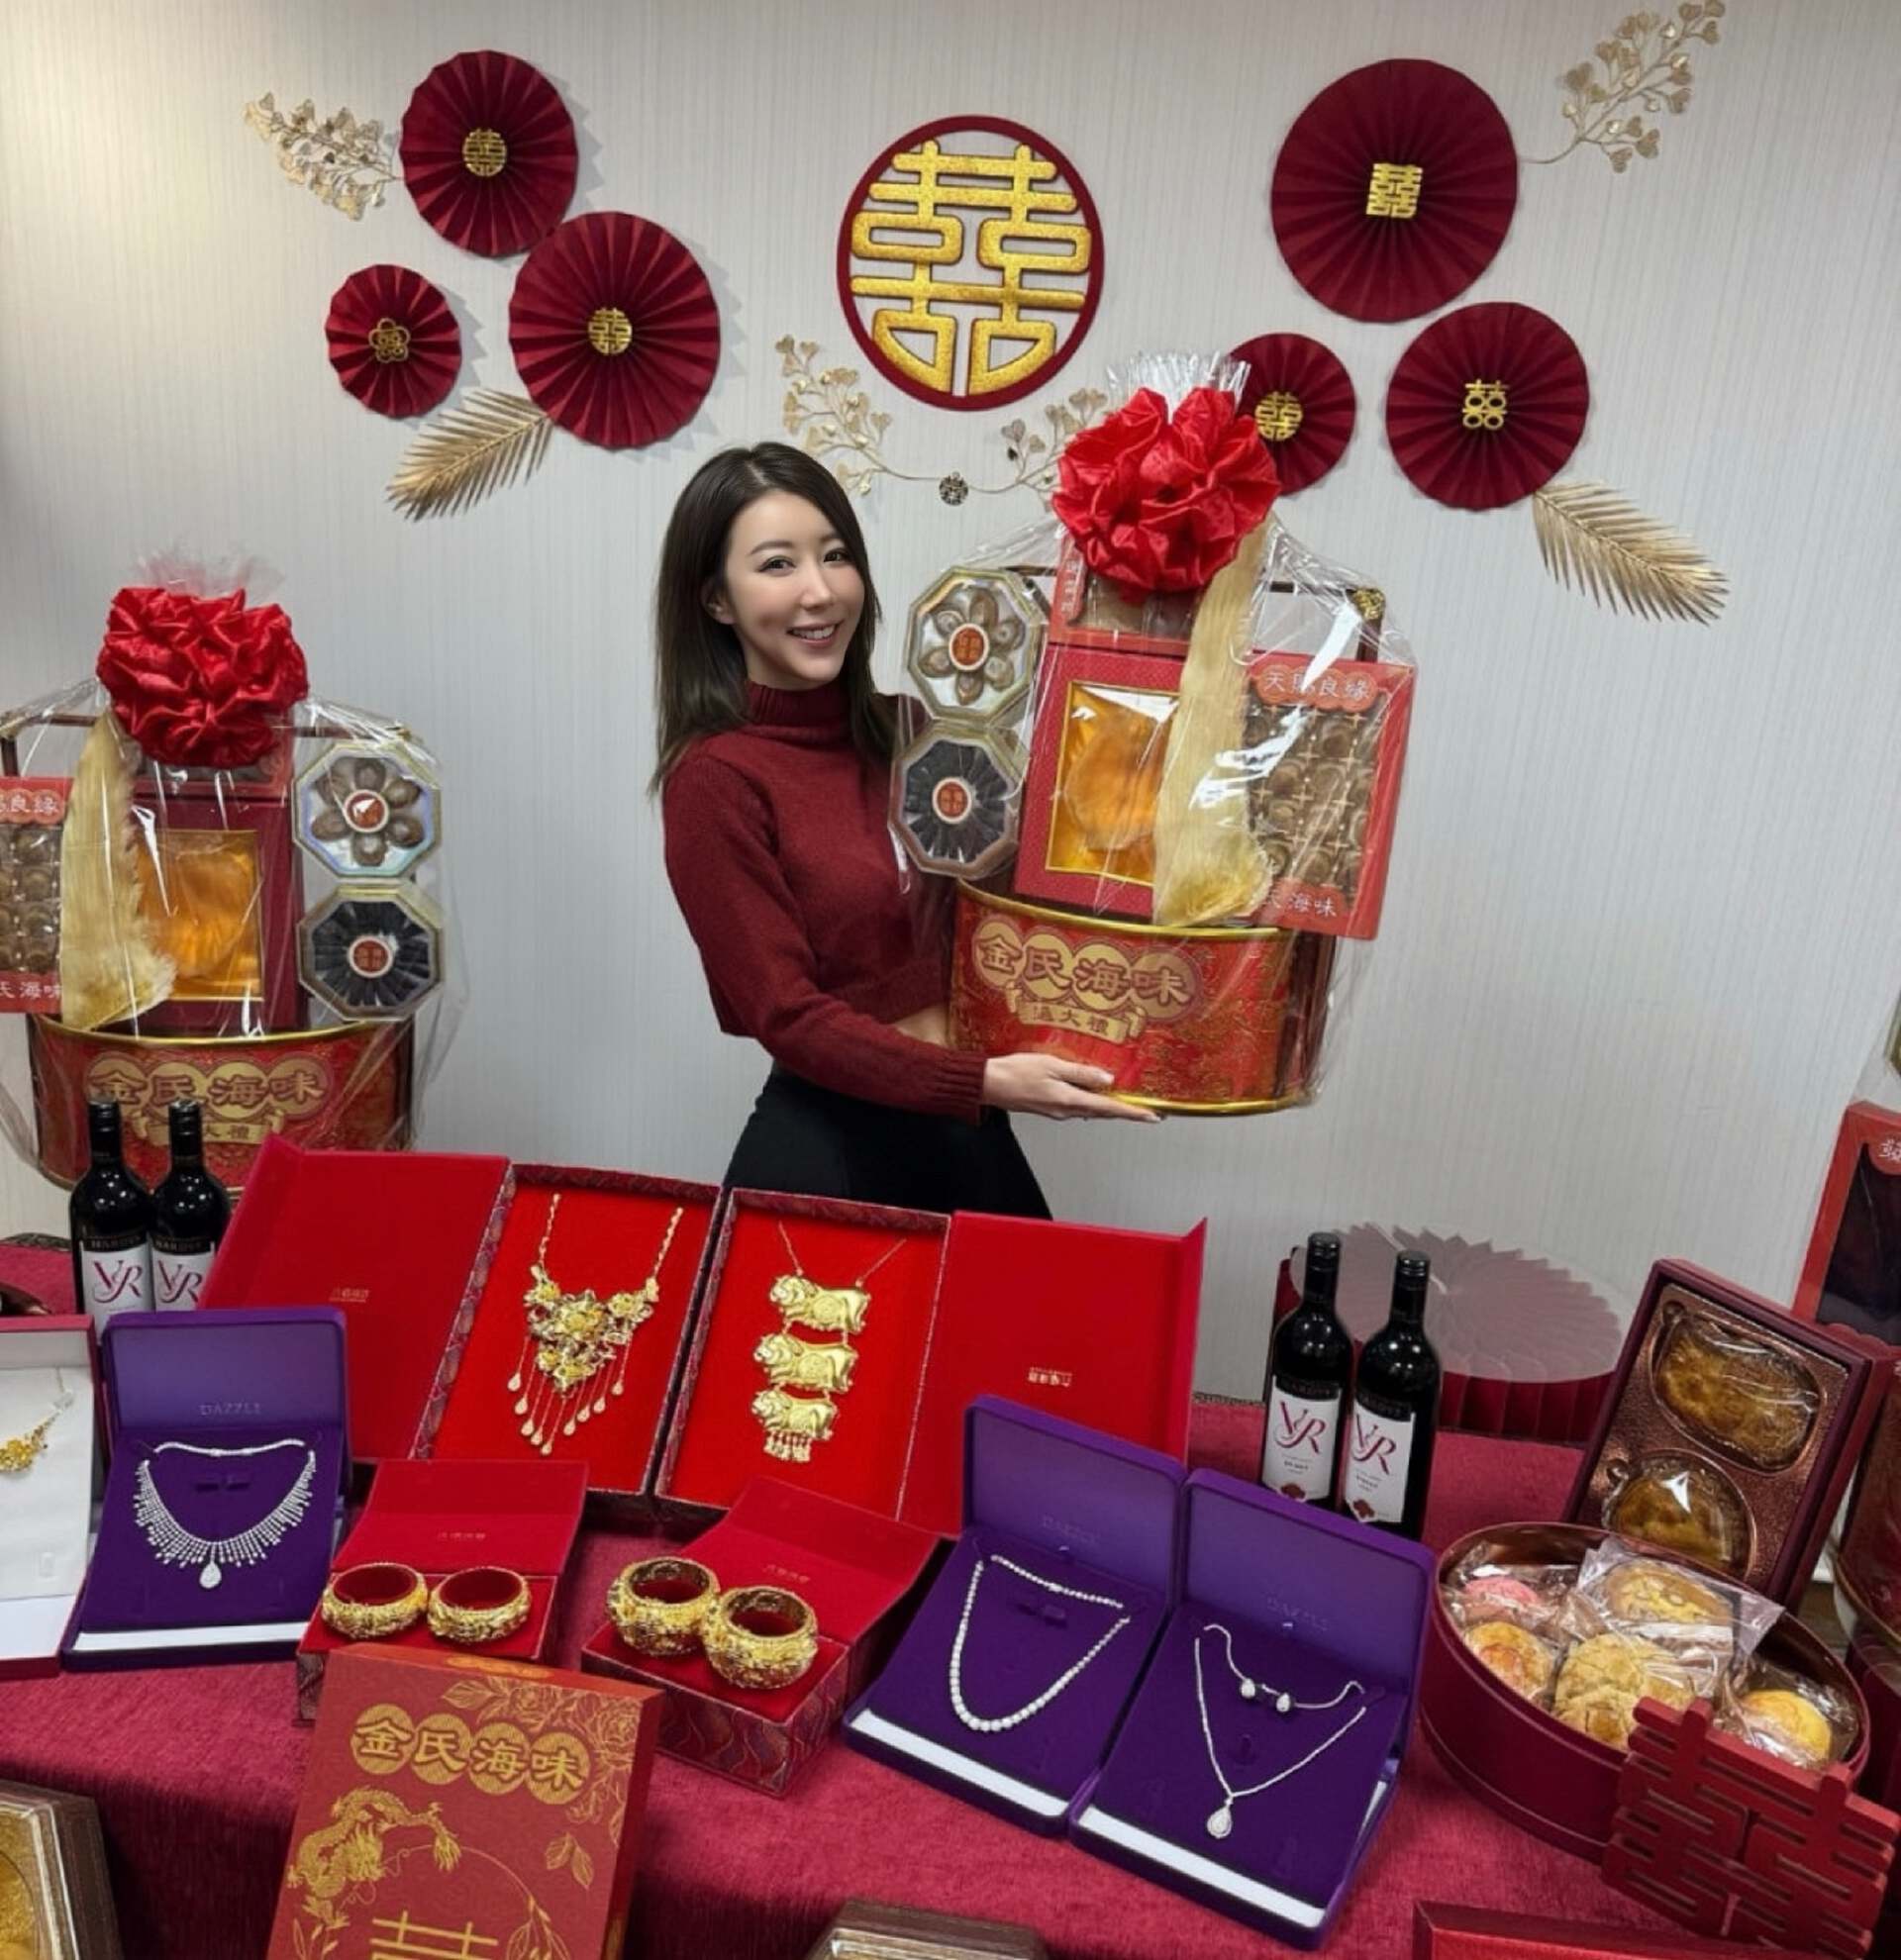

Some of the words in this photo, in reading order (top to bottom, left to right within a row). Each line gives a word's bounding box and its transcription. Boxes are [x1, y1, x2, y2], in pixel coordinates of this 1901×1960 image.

[849, 139, 1093, 395] 囍
[979, 932, 1192, 1008] 金氏海味
[355, 1718, 584, 1790] 金氏海味
